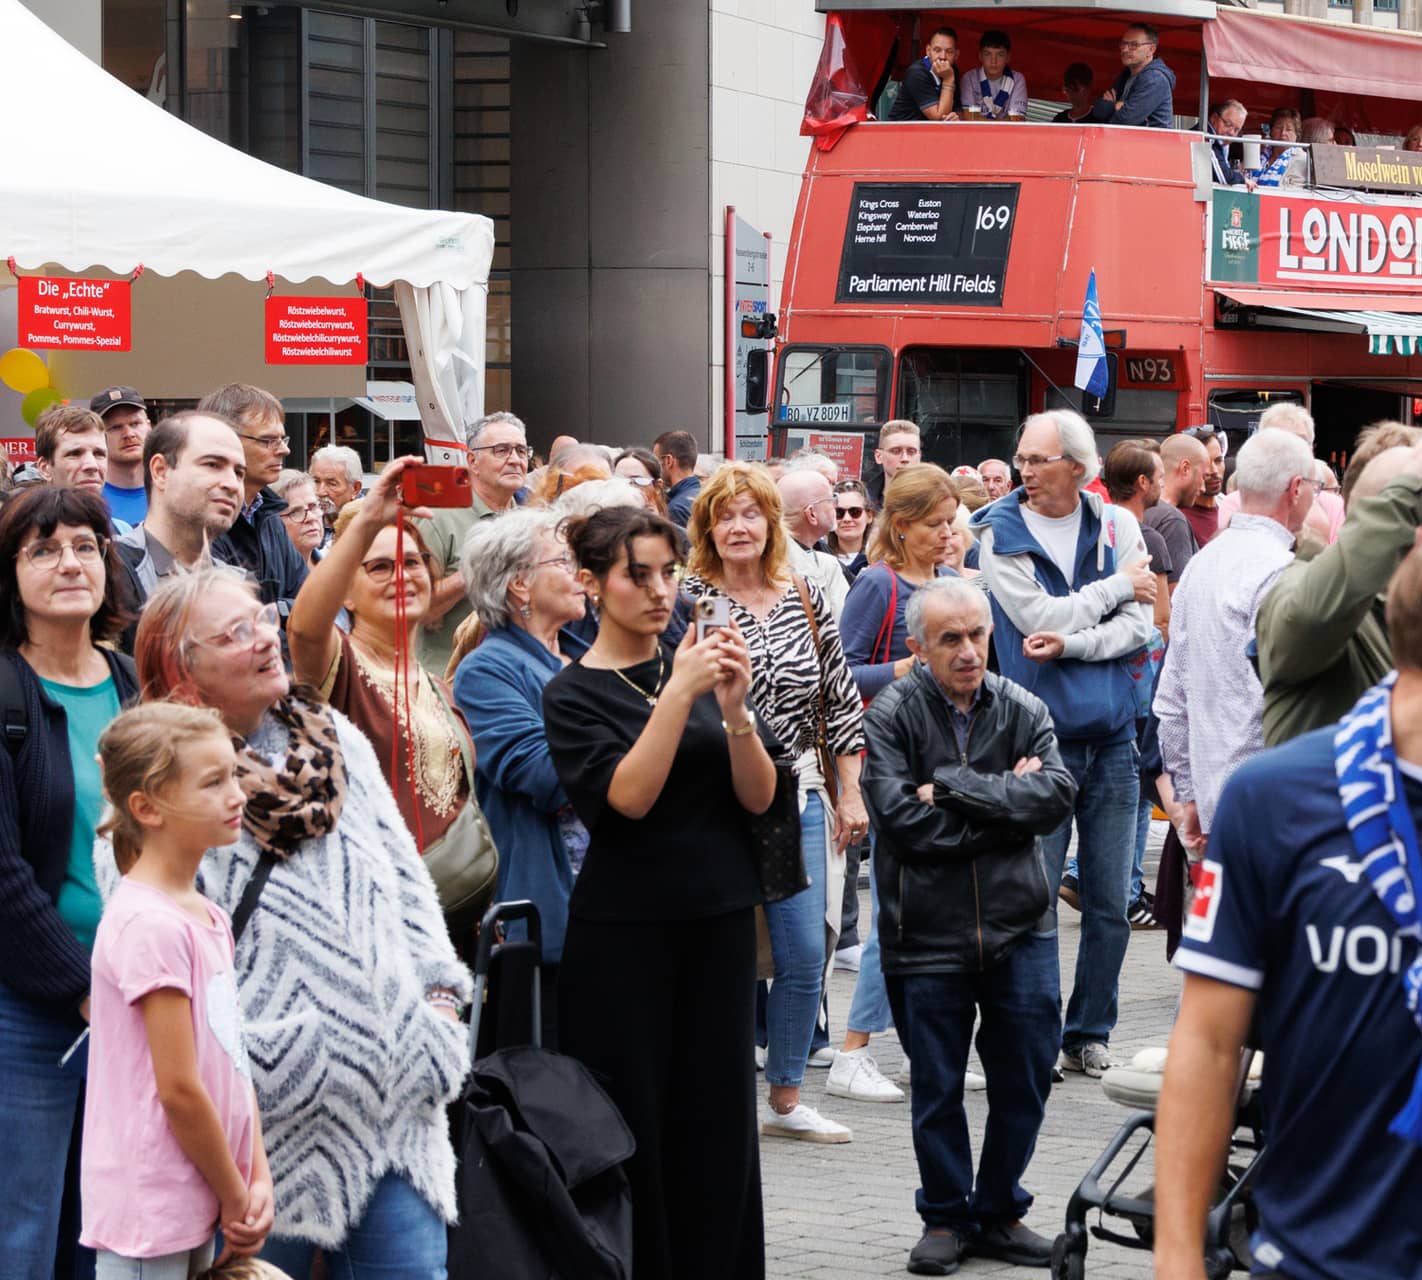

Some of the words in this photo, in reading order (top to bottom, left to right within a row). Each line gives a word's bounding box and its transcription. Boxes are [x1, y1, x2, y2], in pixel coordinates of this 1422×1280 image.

[1344, 151, 1410, 185] Moselwein
[859, 200, 879, 210] Kings
[880, 200, 899, 208] Cross
[918, 199, 942, 207] Euston
[858, 211, 892, 222] Kingsway
[907, 211, 940, 219] Waterloo
[975, 205, 1010, 230] 169
[856, 223, 886, 233] Elephant
[895, 222, 938, 231] Camberwell
[876, 234, 886, 242] hill
[903, 233, 936, 242] Norwood
[38, 280, 59, 296] Die
[849, 273, 926, 293] Parliament
[929, 273, 951, 292] Hill
[953, 274, 996, 293] Fields
[34, 304, 72, 316] Bratwurst,
[73, 306, 115, 318] Chili-Wurst,
[53, 320, 96, 332] Currywurst,
[27, 333, 62, 345] Pommes,
[63, 334, 121, 347] Pommes-Spezial
[1129, 358, 1171, 381] N93
[787, 407, 800, 422] BO
[806, 406, 819, 421] YZ
